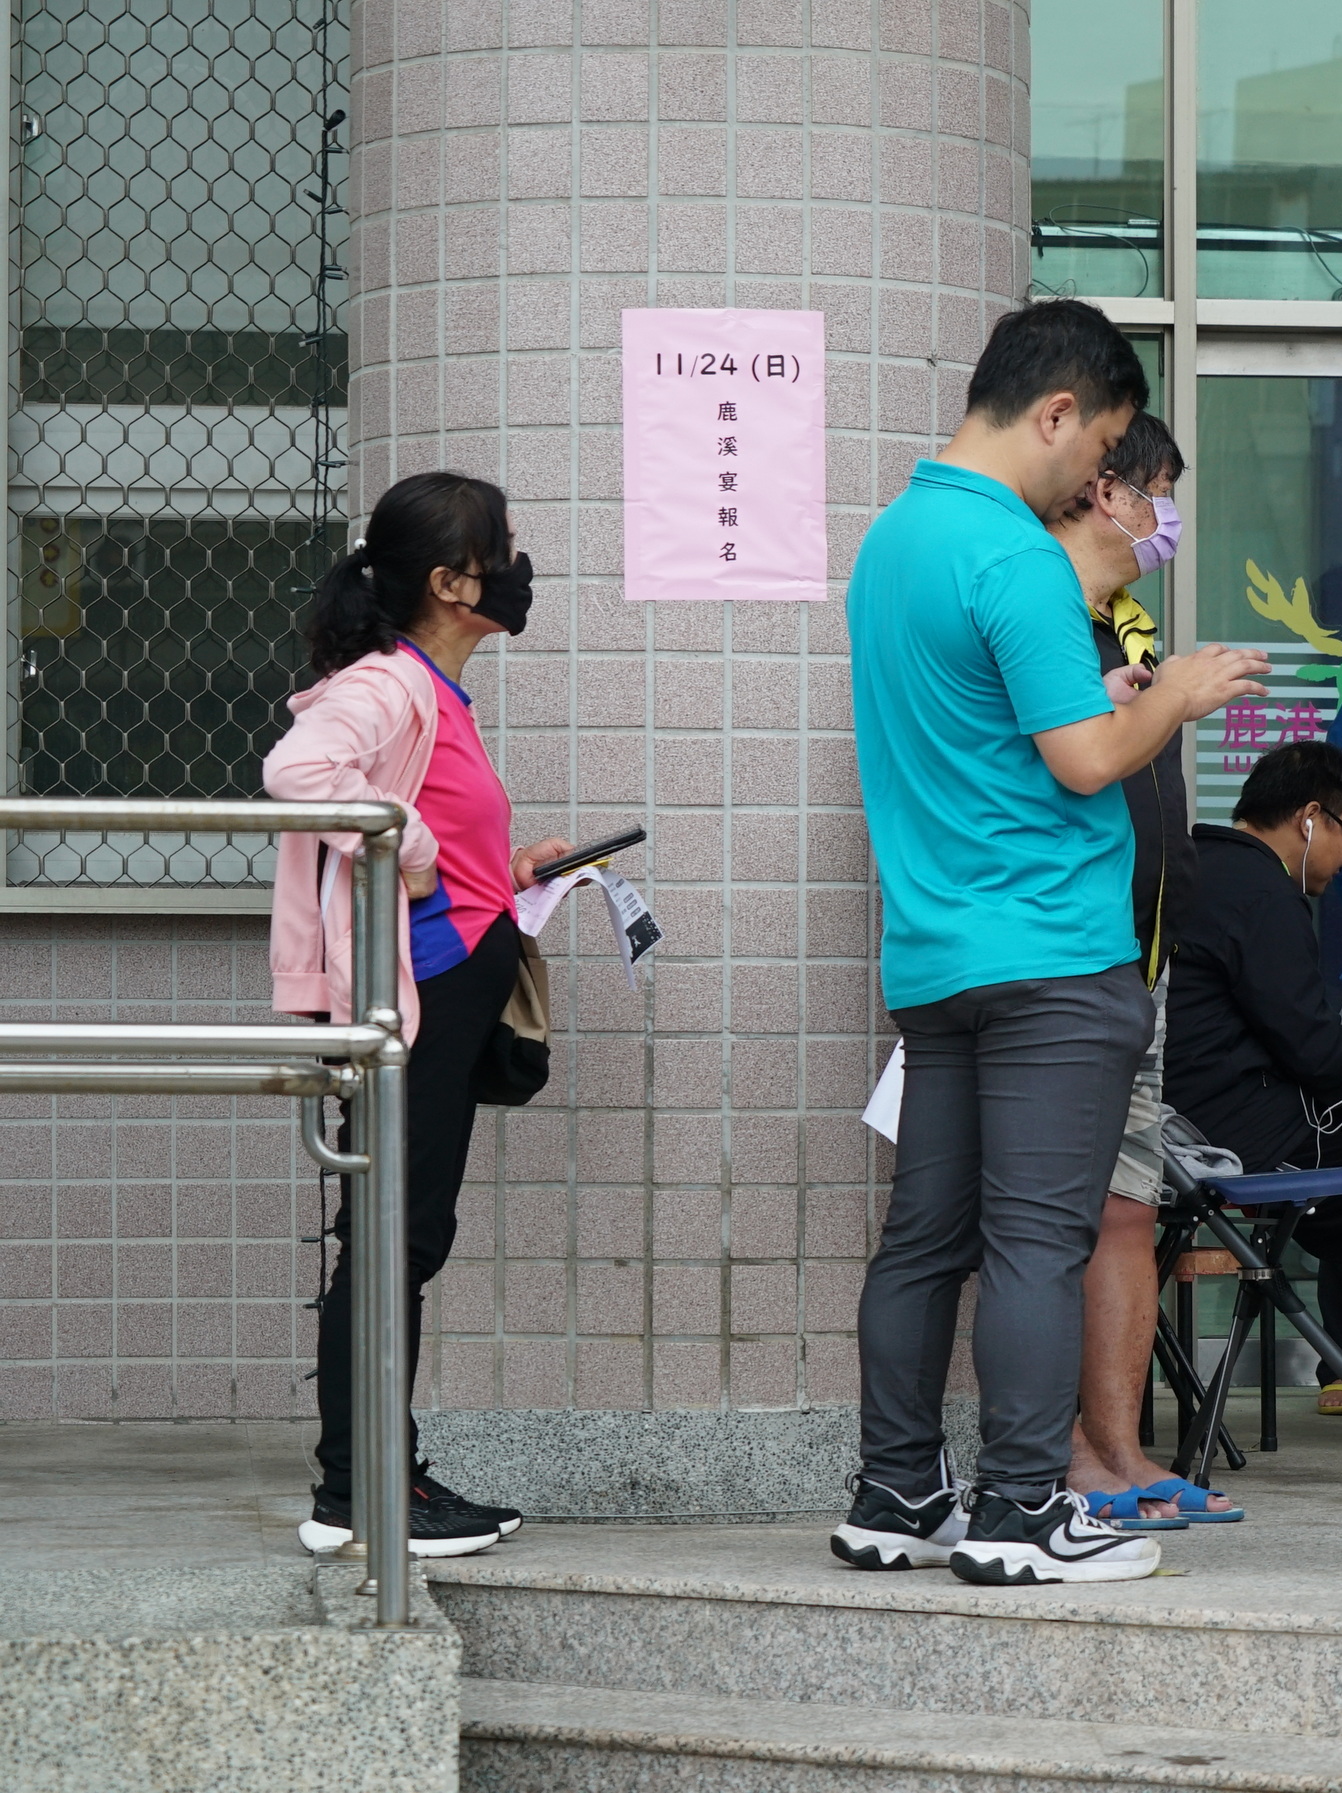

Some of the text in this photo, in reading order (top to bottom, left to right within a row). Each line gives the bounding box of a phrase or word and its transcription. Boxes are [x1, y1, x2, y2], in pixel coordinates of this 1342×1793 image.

[656, 353, 801, 383] 11/24 (日)
[717, 400, 739, 562] 鹿溪宴報名
[1218, 698, 1327, 748] 鹿港
